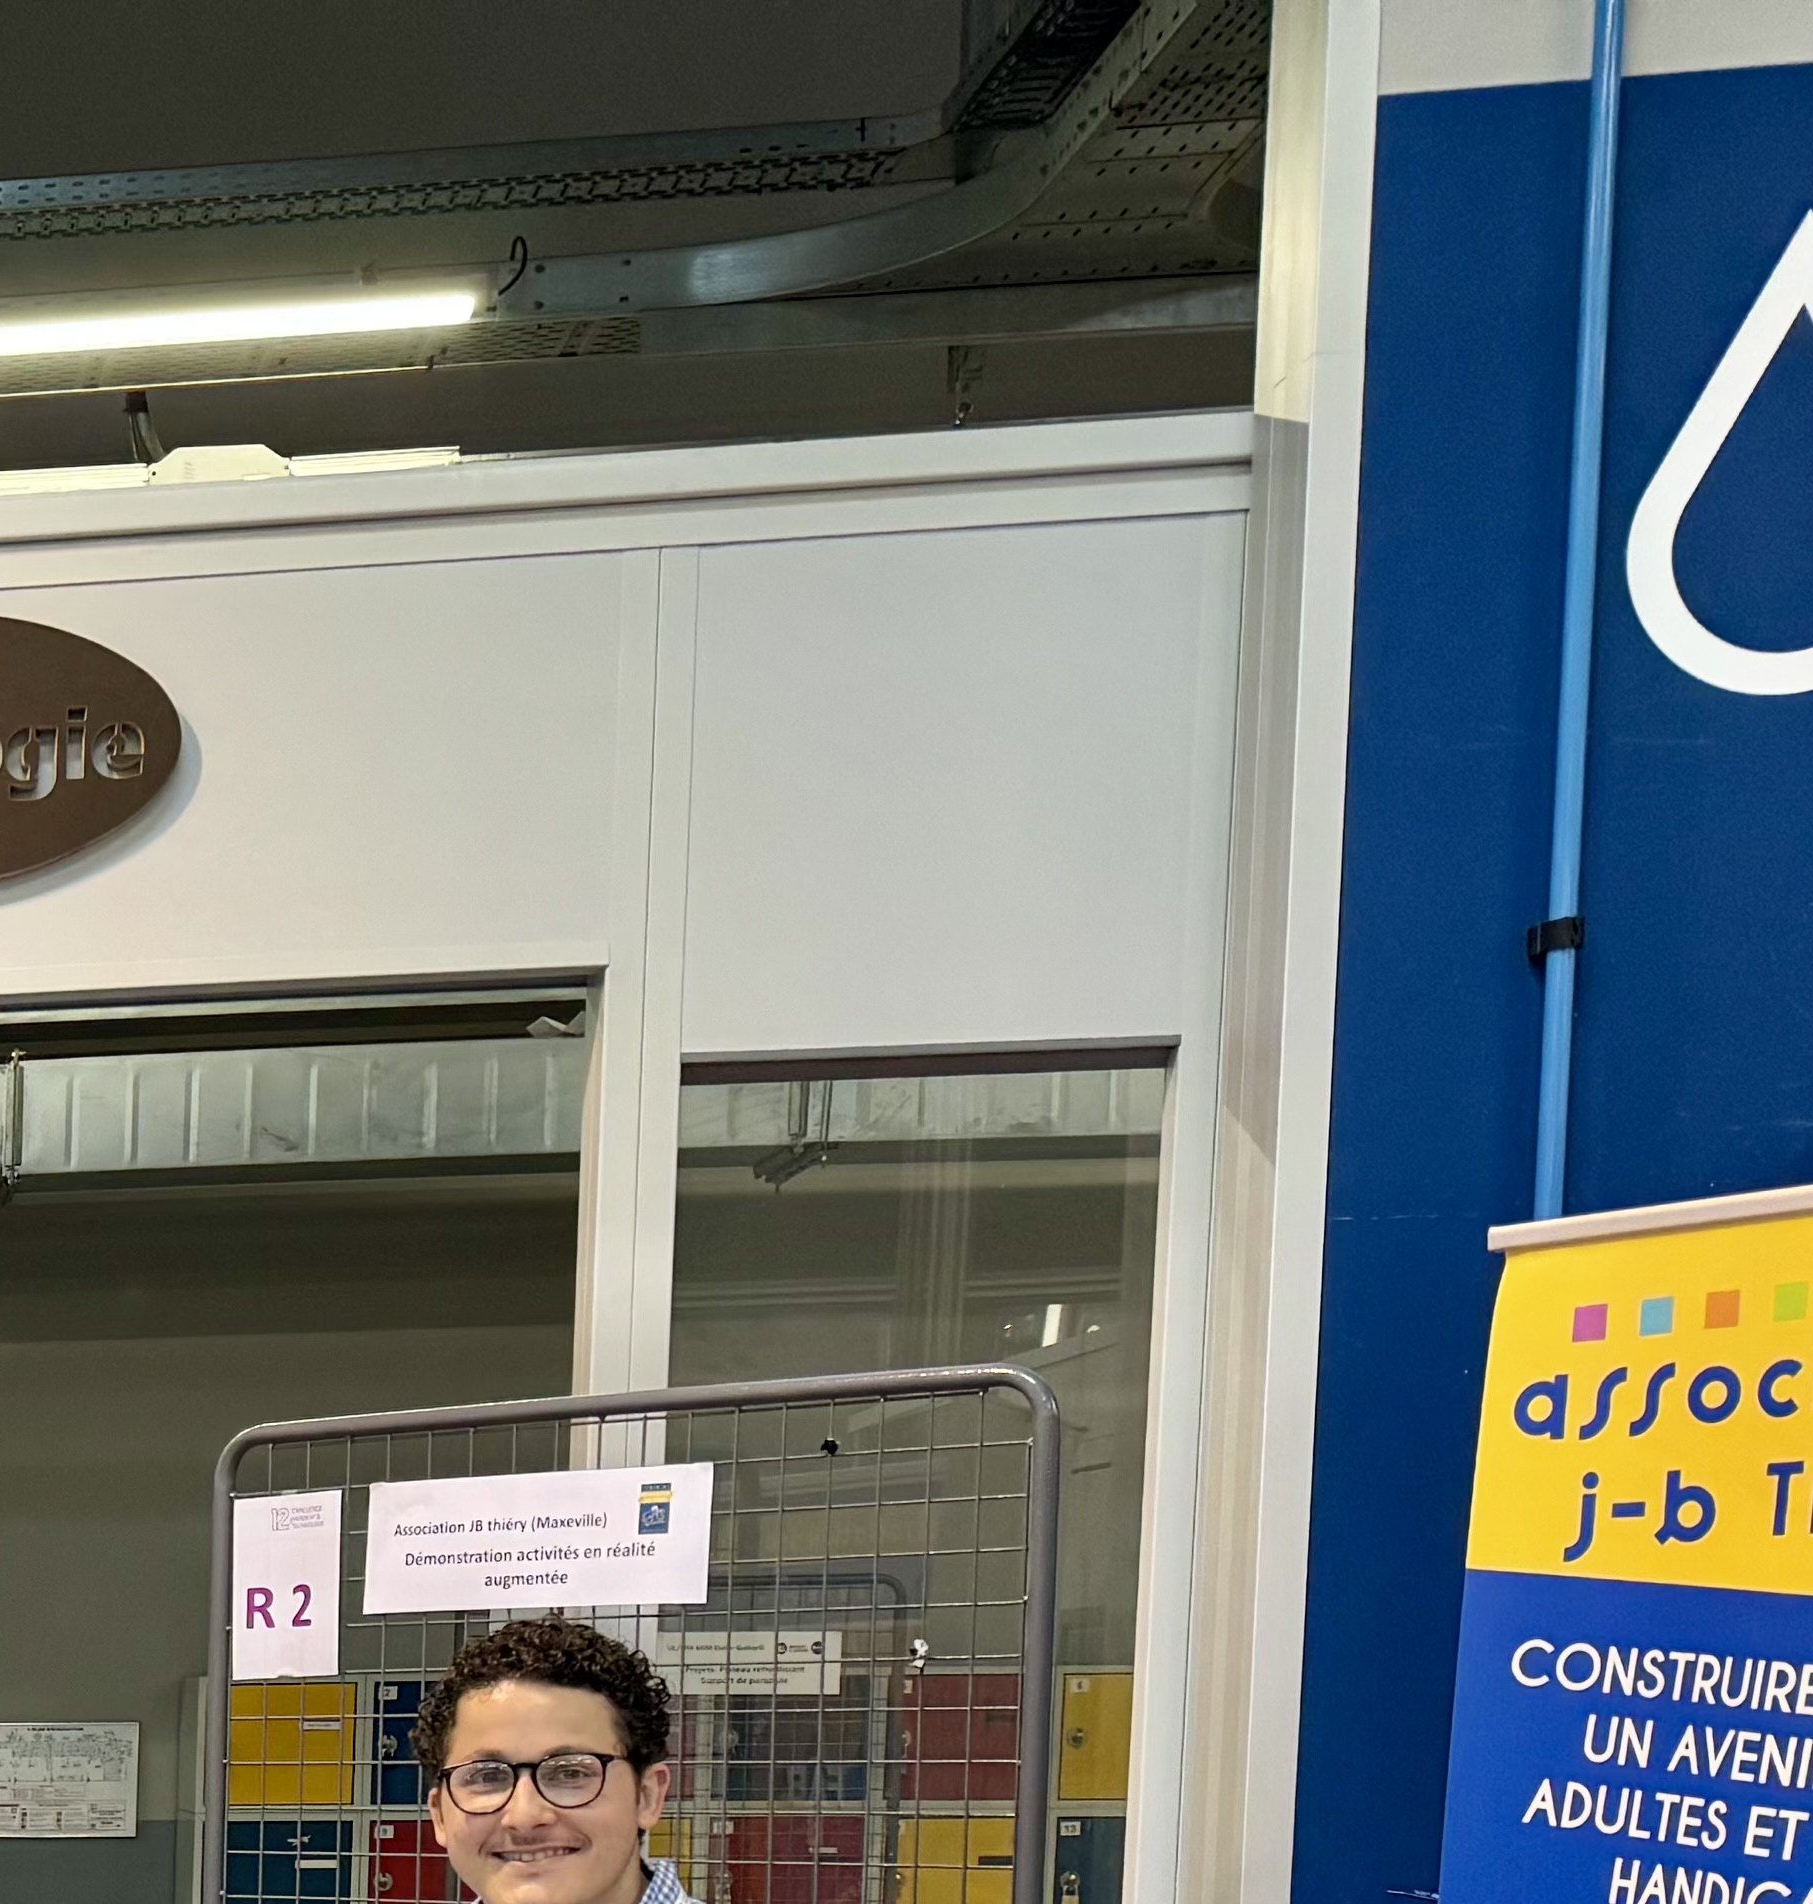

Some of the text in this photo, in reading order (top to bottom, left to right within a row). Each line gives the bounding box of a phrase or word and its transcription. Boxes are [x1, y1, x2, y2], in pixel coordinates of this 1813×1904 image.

[395, 1512, 608, 1537] Association JB thiéry (Maxeville)
[1564, 1470, 1715, 1562] j-b
[405, 1542, 655, 1567] Démonstration activités en réalité
[485, 1570, 569, 1589] augmentée
[246, 1584, 312, 1629] R 2
[1511, 1639, 1813, 1716] CONSTRUIRE
[1584, 1714, 1653, 1768] UN
[1522, 1779, 1810, 1860] ADULTES ET
